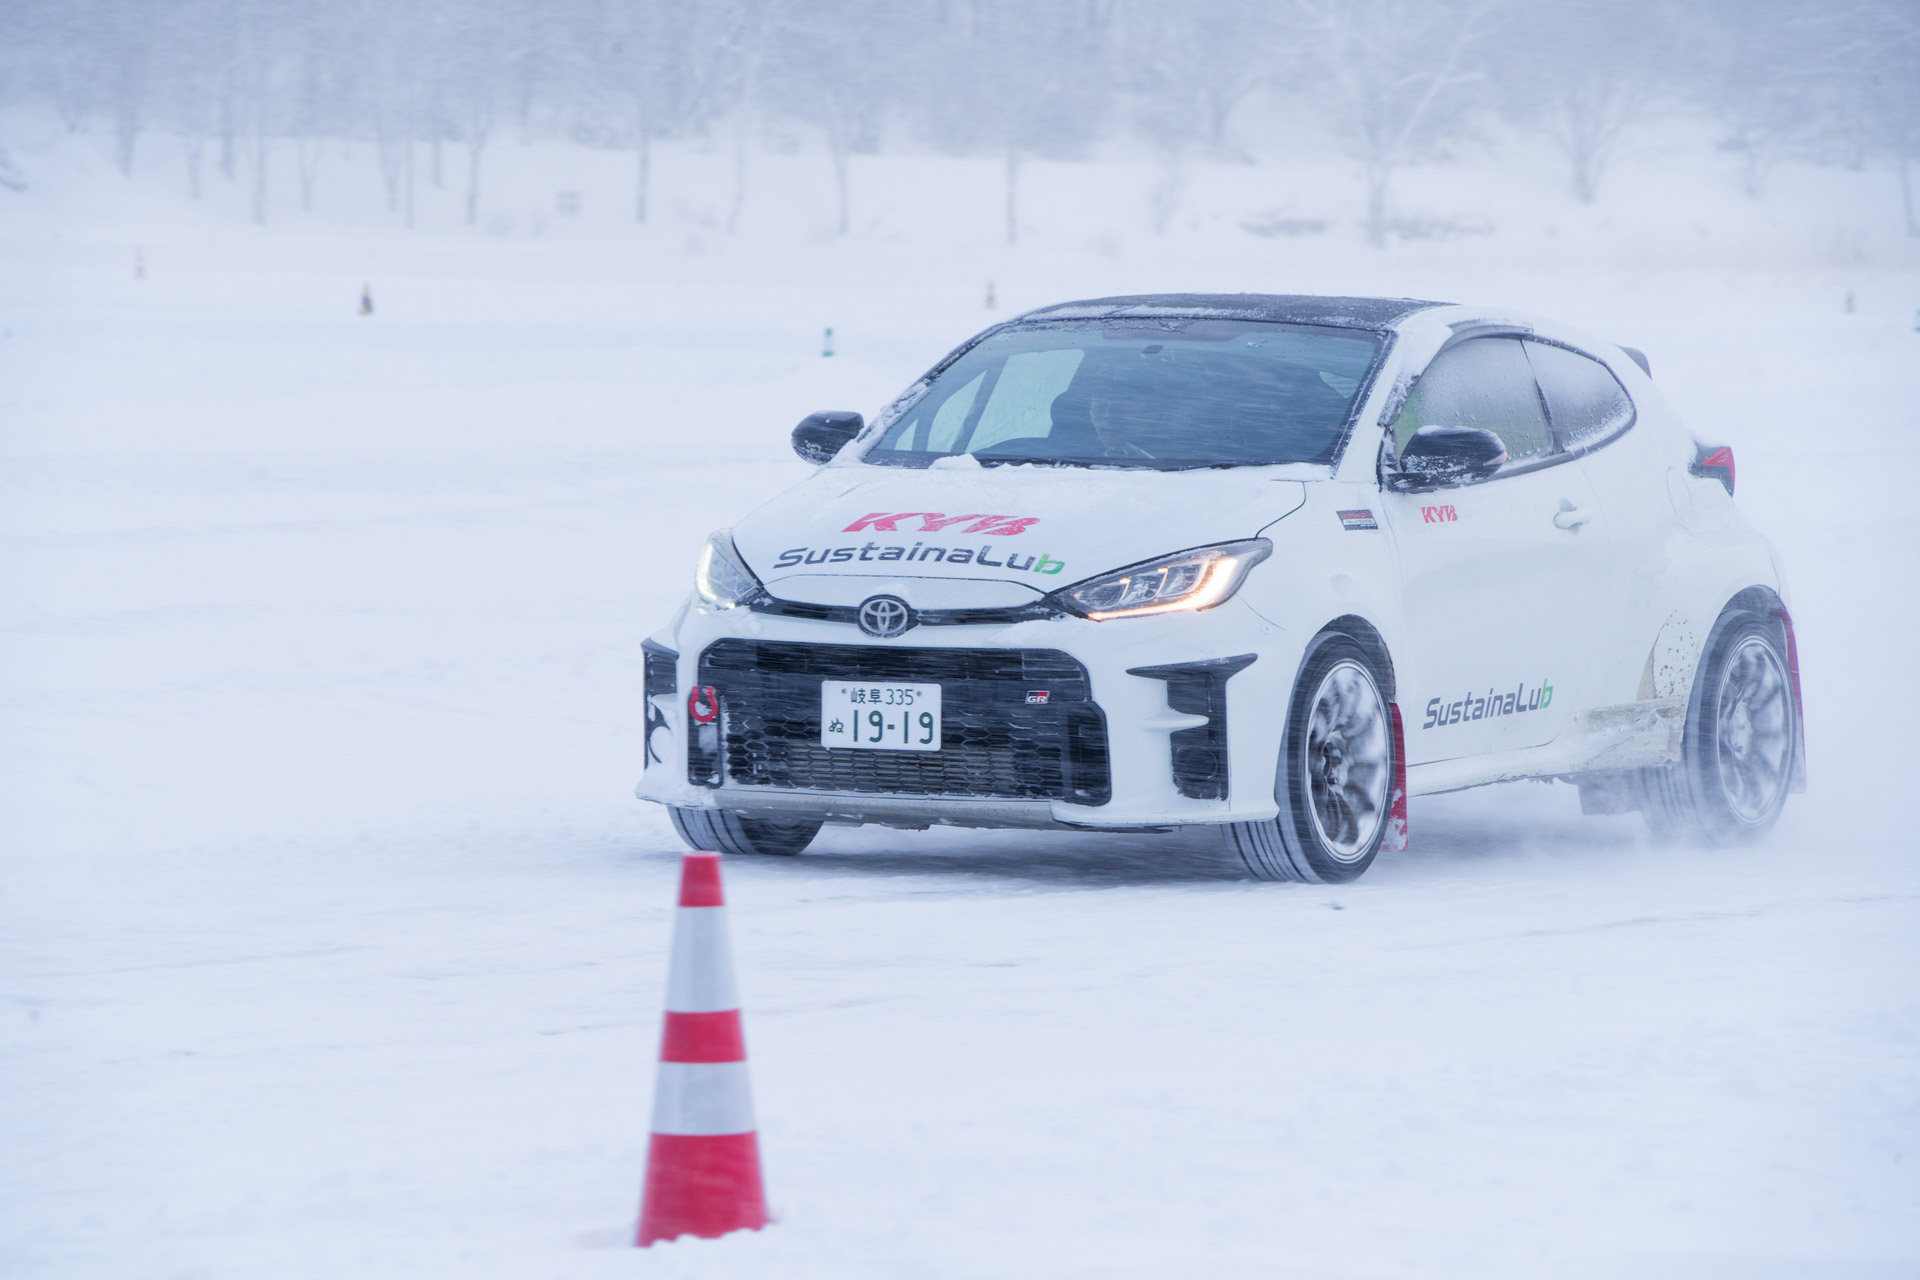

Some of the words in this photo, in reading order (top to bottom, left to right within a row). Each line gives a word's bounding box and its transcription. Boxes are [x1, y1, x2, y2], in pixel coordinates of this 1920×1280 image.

[841, 513, 1040, 536] KYB
[1421, 505, 1458, 523] KYB
[772, 542, 1065, 575] SustainaLub
[885, 689, 914, 705] 335
[1027, 695, 1048, 703] GR
[1423, 678, 1553, 729] SustainaLub
[829, 718, 844, 733] ぬ
[853, 710, 934, 744] 19-19
